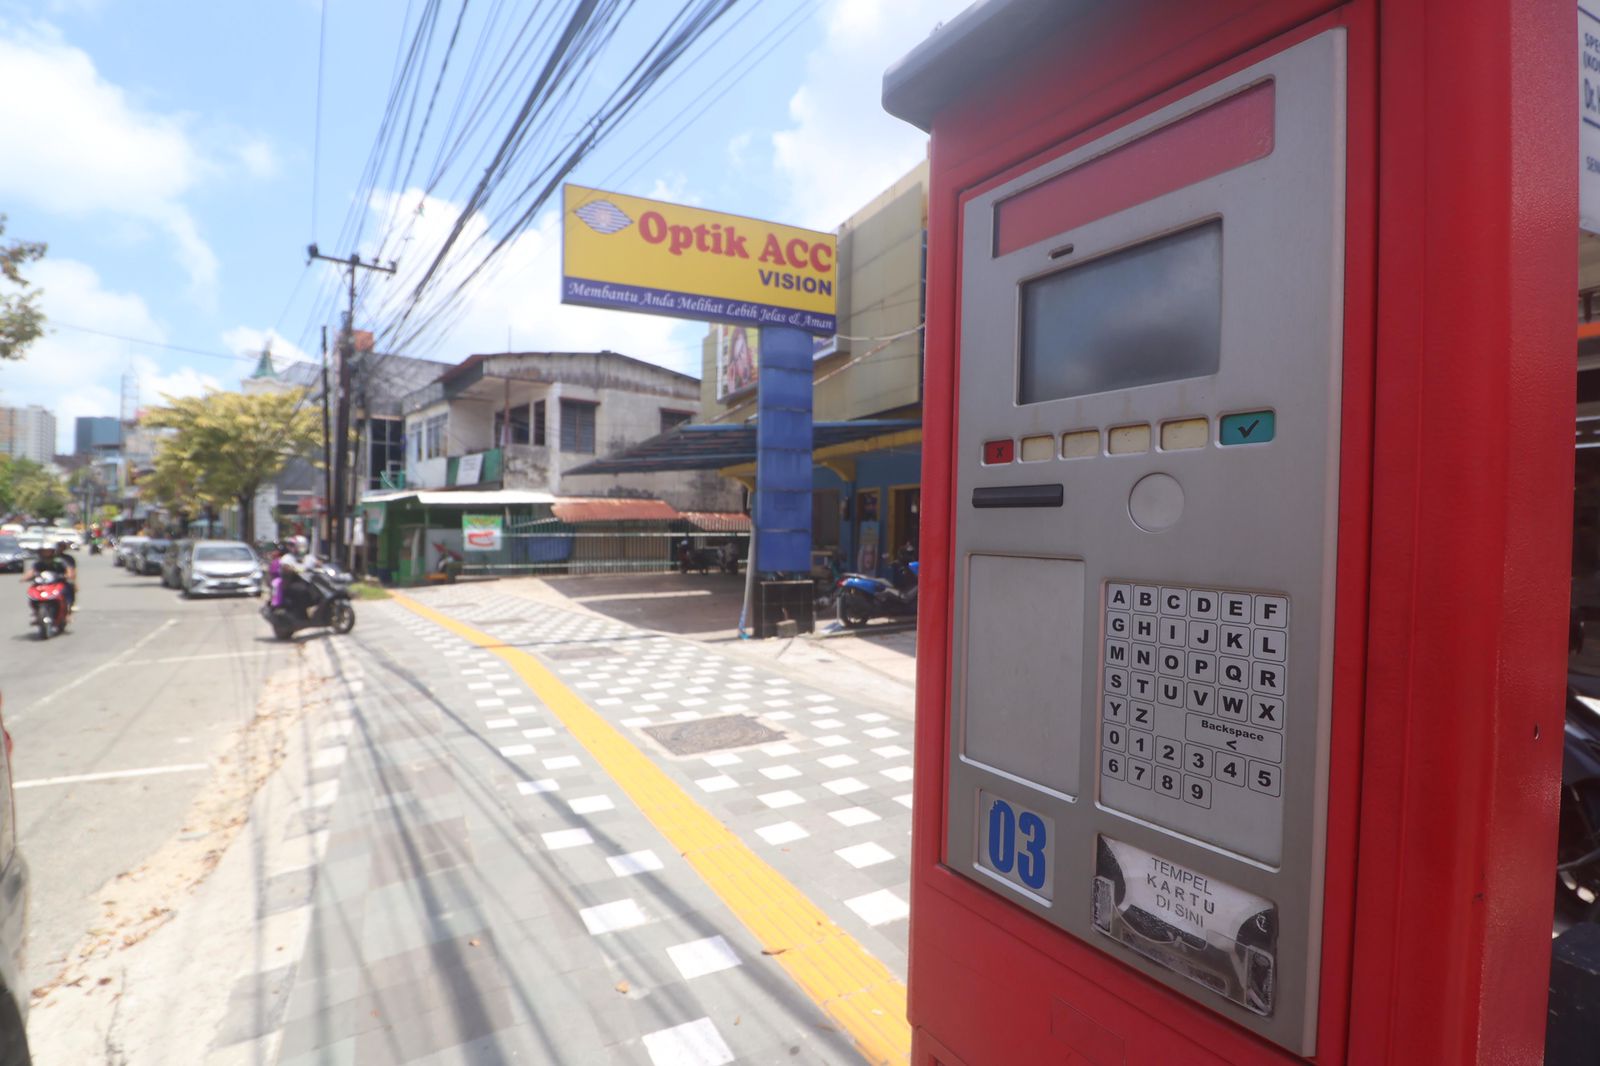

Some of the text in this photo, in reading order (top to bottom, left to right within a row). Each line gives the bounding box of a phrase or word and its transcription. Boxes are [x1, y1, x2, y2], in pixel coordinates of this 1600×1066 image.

[638, 211, 832, 273] Optik ACC
[758, 269, 832, 297] VISION
[568, 282, 833, 330] Membantu Anda Melihat Lebih Jelas & Aman
[1113, 590, 1277, 619] A B C D E F
[1112, 618, 1276, 654] G H I J K L
[1111, 646, 1276, 688] M N O P Q R
[1110, 702, 1148, 724] Y Z
[1111, 674, 1275, 721] S T U V W X
[1201, 719, 1264, 743] Backspace
[1110, 731, 1271, 787] 0 1 2 3 4 5
[1109, 759, 1203, 800] 6 7 8 9
[988, 799, 1047, 890] 03
[1151, 857, 1214, 896] TEMPEL
[1156, 894, 1204, 928] DI SINI
